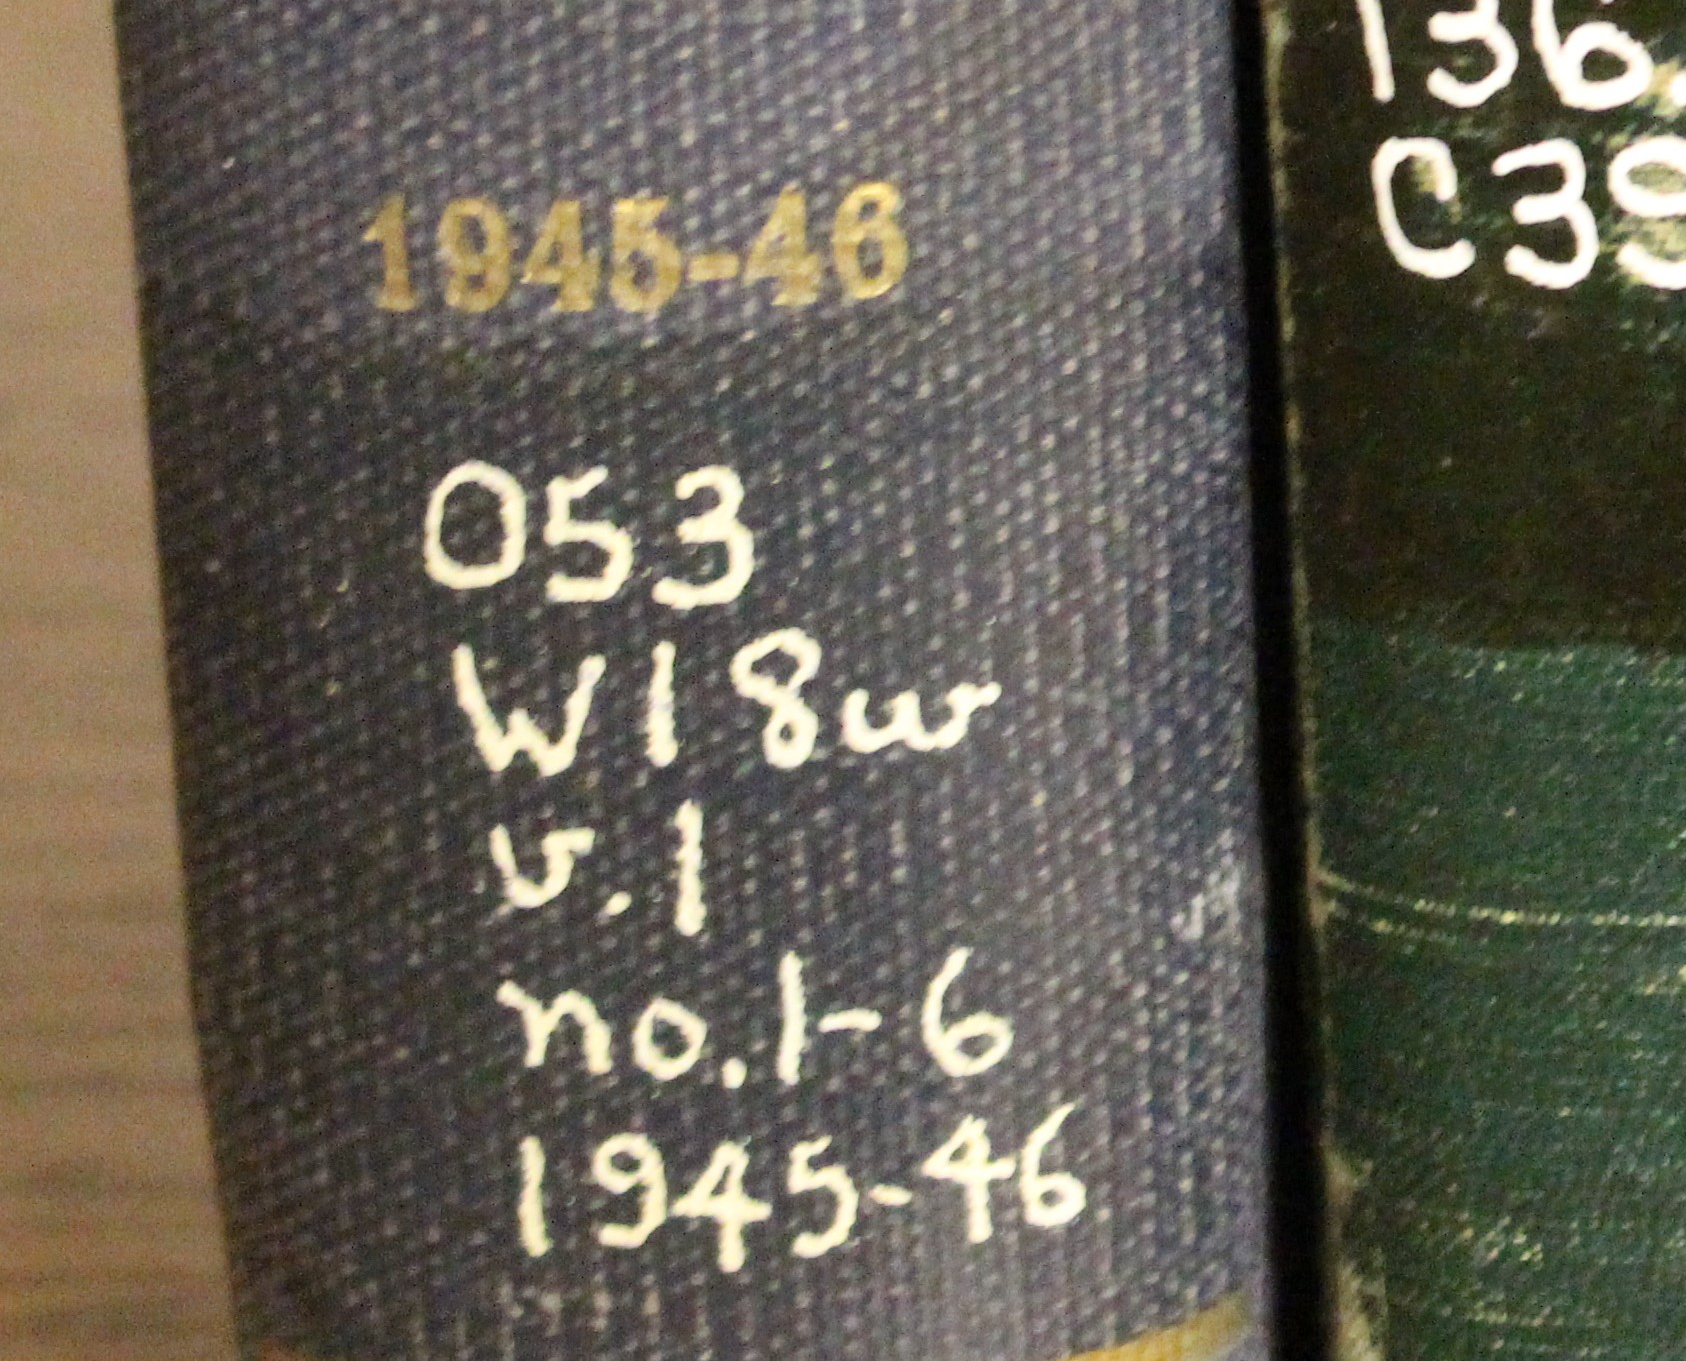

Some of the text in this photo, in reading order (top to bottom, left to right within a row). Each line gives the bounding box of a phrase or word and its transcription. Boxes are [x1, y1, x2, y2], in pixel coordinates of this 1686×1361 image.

[367, 180, 909, 313] 1945-46
[422, 462, 755, 610] 053
[518, 1104, 1087, 1274] 1945-46
